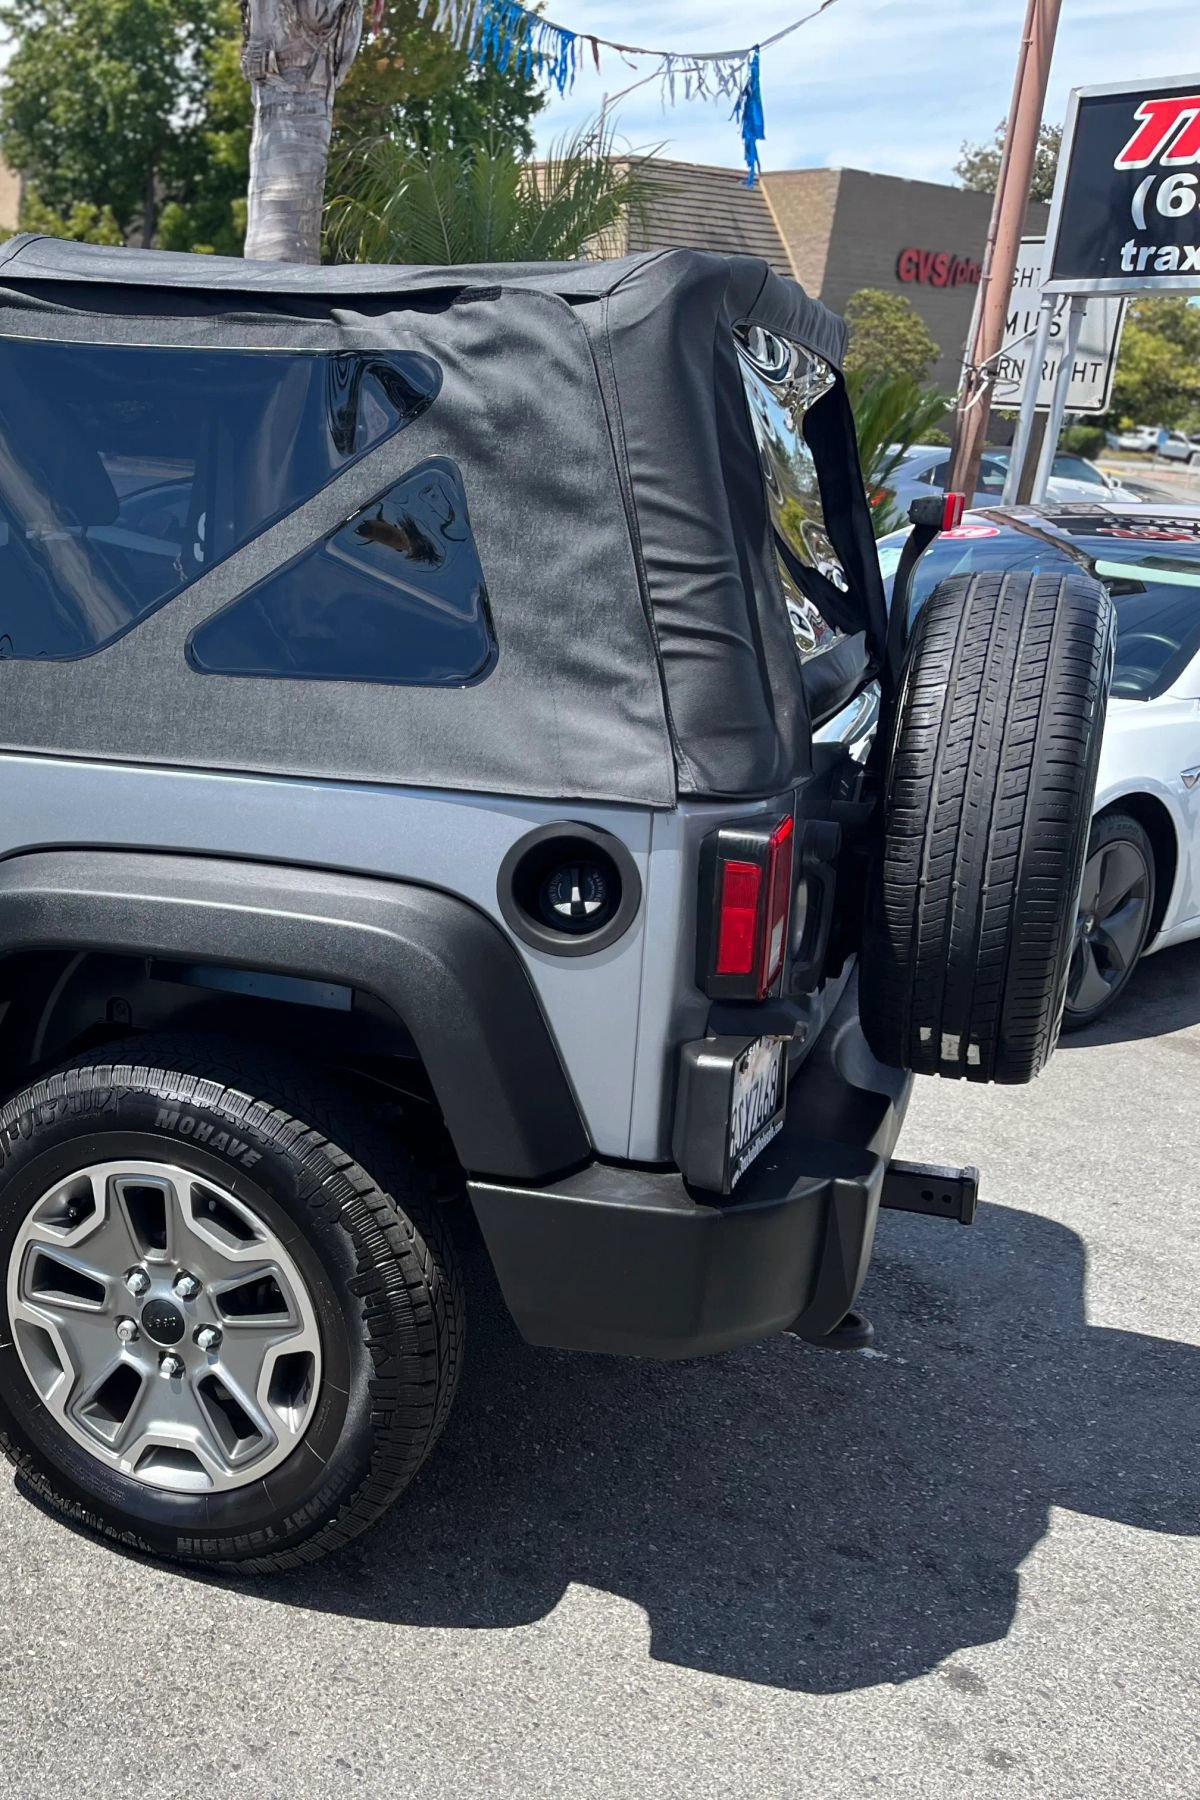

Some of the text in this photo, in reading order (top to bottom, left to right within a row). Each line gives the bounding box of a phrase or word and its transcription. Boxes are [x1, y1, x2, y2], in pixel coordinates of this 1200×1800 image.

[1131, 172, 1200, 231] (6
[1041, 361, 1102, 383] RIHT
[154, 1108, 263, 1168] MOHAVE
